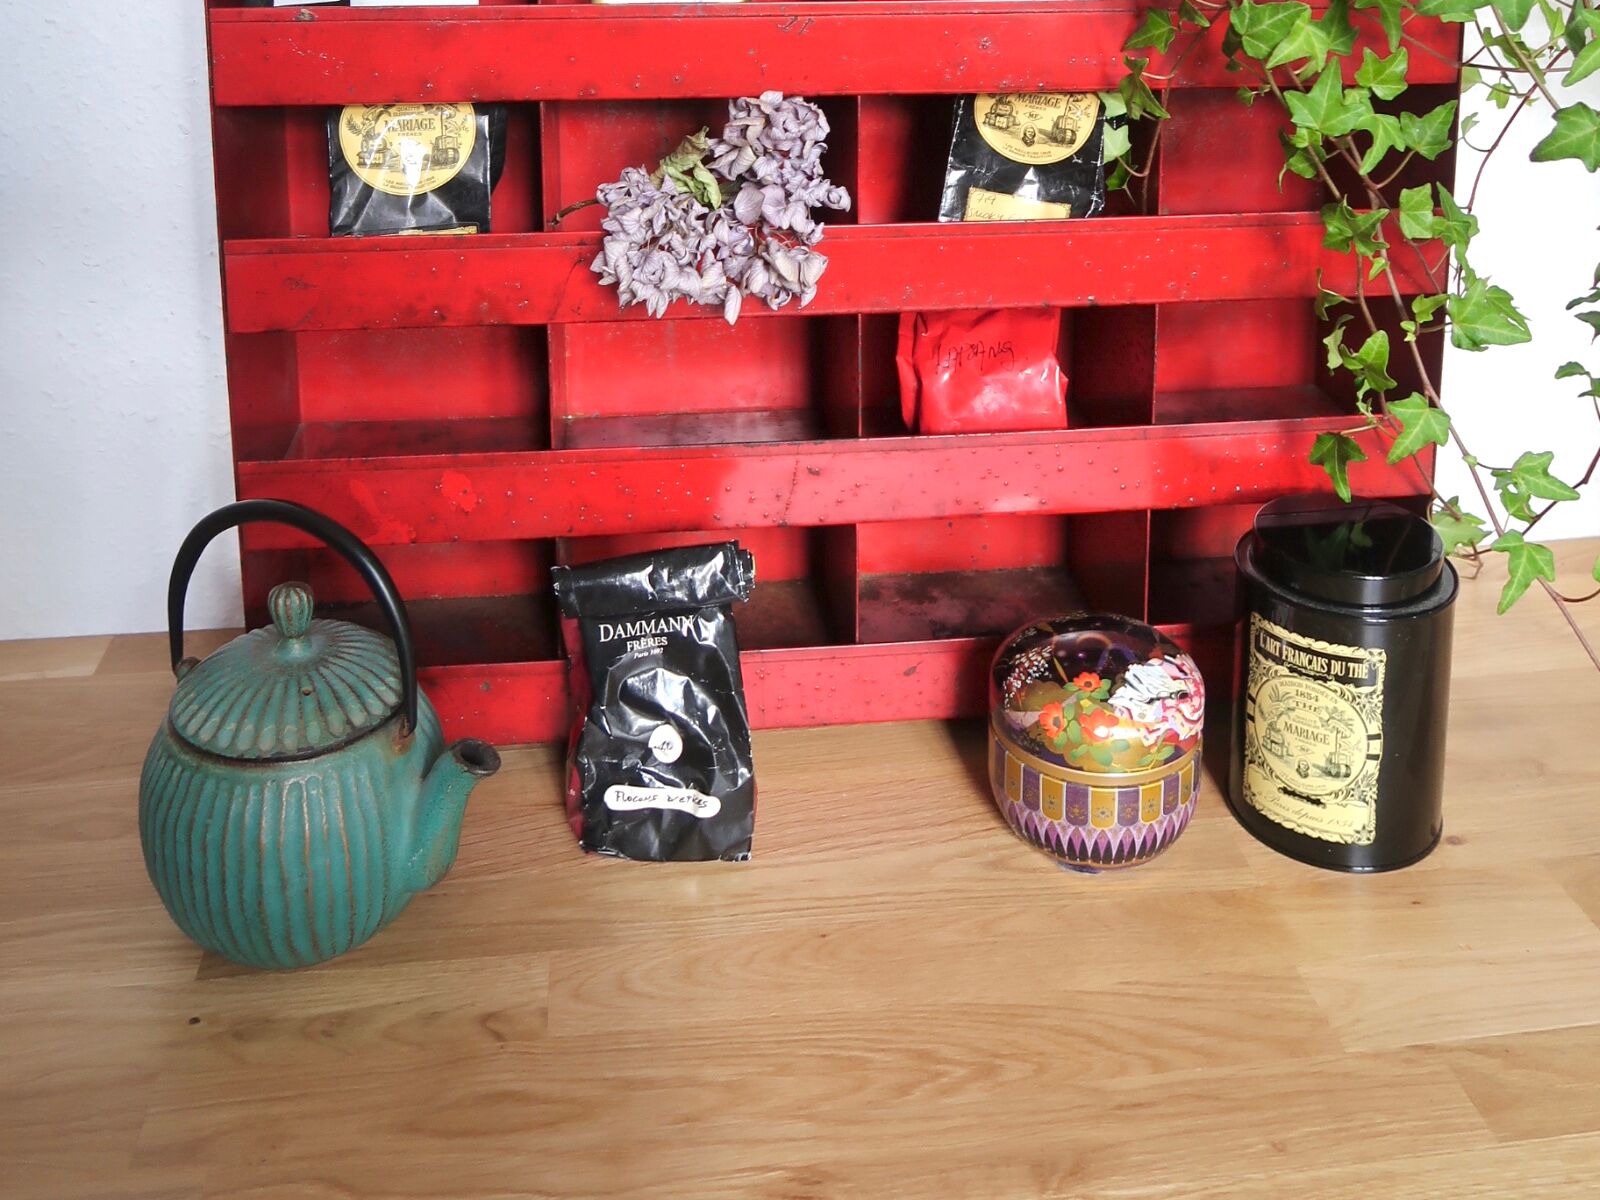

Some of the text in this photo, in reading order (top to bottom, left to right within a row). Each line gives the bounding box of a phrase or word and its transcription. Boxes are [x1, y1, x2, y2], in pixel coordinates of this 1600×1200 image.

[1015, 93, 1063, 109] MARIAGE
[599, 615, 694, 643] DAMMANN
[626, 635, 668, 652] FRÈRES
[1259, 631, 1281, 657] L'ART
[1282, 641, 1329, 673] FRANÇAIS
[1330, 659, 1346, 677] DU
[633, 651, 649, 660] Paris
[1283, 720, 1331, 746] MARIAGE
